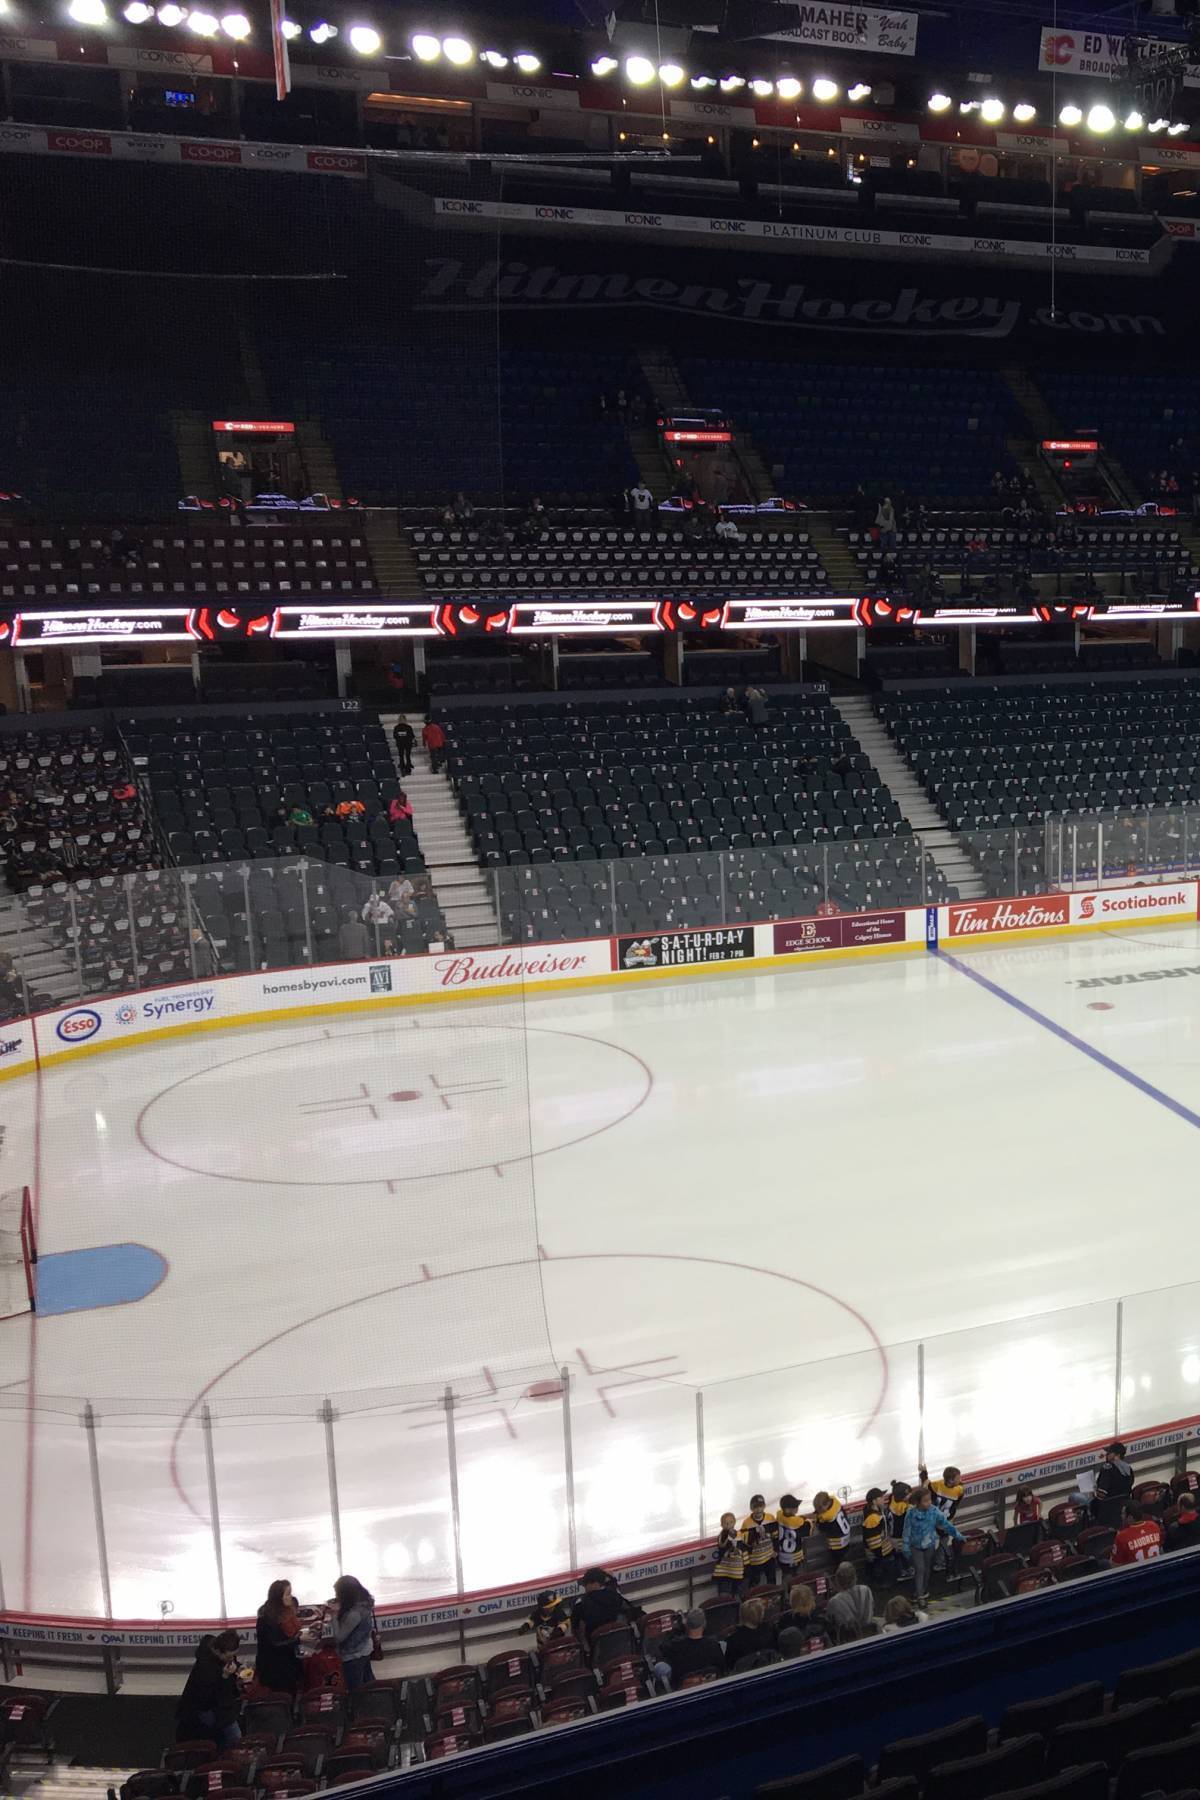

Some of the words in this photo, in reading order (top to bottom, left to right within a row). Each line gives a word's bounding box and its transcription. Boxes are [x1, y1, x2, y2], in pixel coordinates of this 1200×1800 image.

[800, 6, 868, 29] MAHER
[1084, 35, 1101, 53] ED
[55, 135, 103, 150] CO-OP
[314, 155, 358, 169] CO-OP
[442, 201, 482, 213] ICONIC
[535, 207, 574, 219] ICONIC
[625, 214, 662, 226] ICONIC
[710, 220, 746, 232] ICONIC
[763, 224, 839, 241] PLATINUM
[844, 231, 882, 243] CLUB
[900, 234, 931, 246] ICONIC
[974, 240, 1005, 250] ICONIC
[1115, 250, 1145, 261] ICONIC
[342, 700, 359, 710] 122
[1102, 892, 1186, 912] Scotiabank
[953, 907, 988, 934] Tim
[992, 904, 1064, 930] Hortons
[661, 929, 744, 950] S-A-T-U-R-D-A-Y
[805, 936, 832, 945] SCHOOL
[662, 947, 707, 964] NIGHT!
[709, 952, 719, 960] FEB
[434, 952, 587, 985] Budweiser
[263, 975, 367, 994] homesbyavi.com
[143, 994, 214, 1019] Synergy
[64, 1019, 94, 1034] Esso
[1129, 1438, 1156, 1451] KEEPING
[1157, 1436, 1164, 1446] IT
[1164, 1432, 1184, 1445] FRESH
[1039, 1462, 1067, 1476] KEEPING
[1067, 1459, 1074, 1469] IT
[1075, 1454, 1096, 1468] FRESH
[982, 1479, 1003, 1492] FRESH
[625, 1565, 658, 1580] KEEPING
[659, 1564, 667, 1573] IT
[669, 1555, 695, 1570] FRESH
[506, 1592, 538, 1608] KEEPIN
[381, 1615, 418, 1629] KEEPING
[420, 1613, 429, 1623] IT
[430, 1608, 458, 1622] FRESH
[12, 1628, 48, 1640] KEEPING
[50, 1630, 57, 1640] IT
[58, 1631, 83, 1641] FRESH
[101, 1634, 126, 1645] OPA!
[128, 1634, 165, 1645] KEEPING
[166, 1634, 174, 1645] IT
[175, 1634, 200, 1645] FRES
